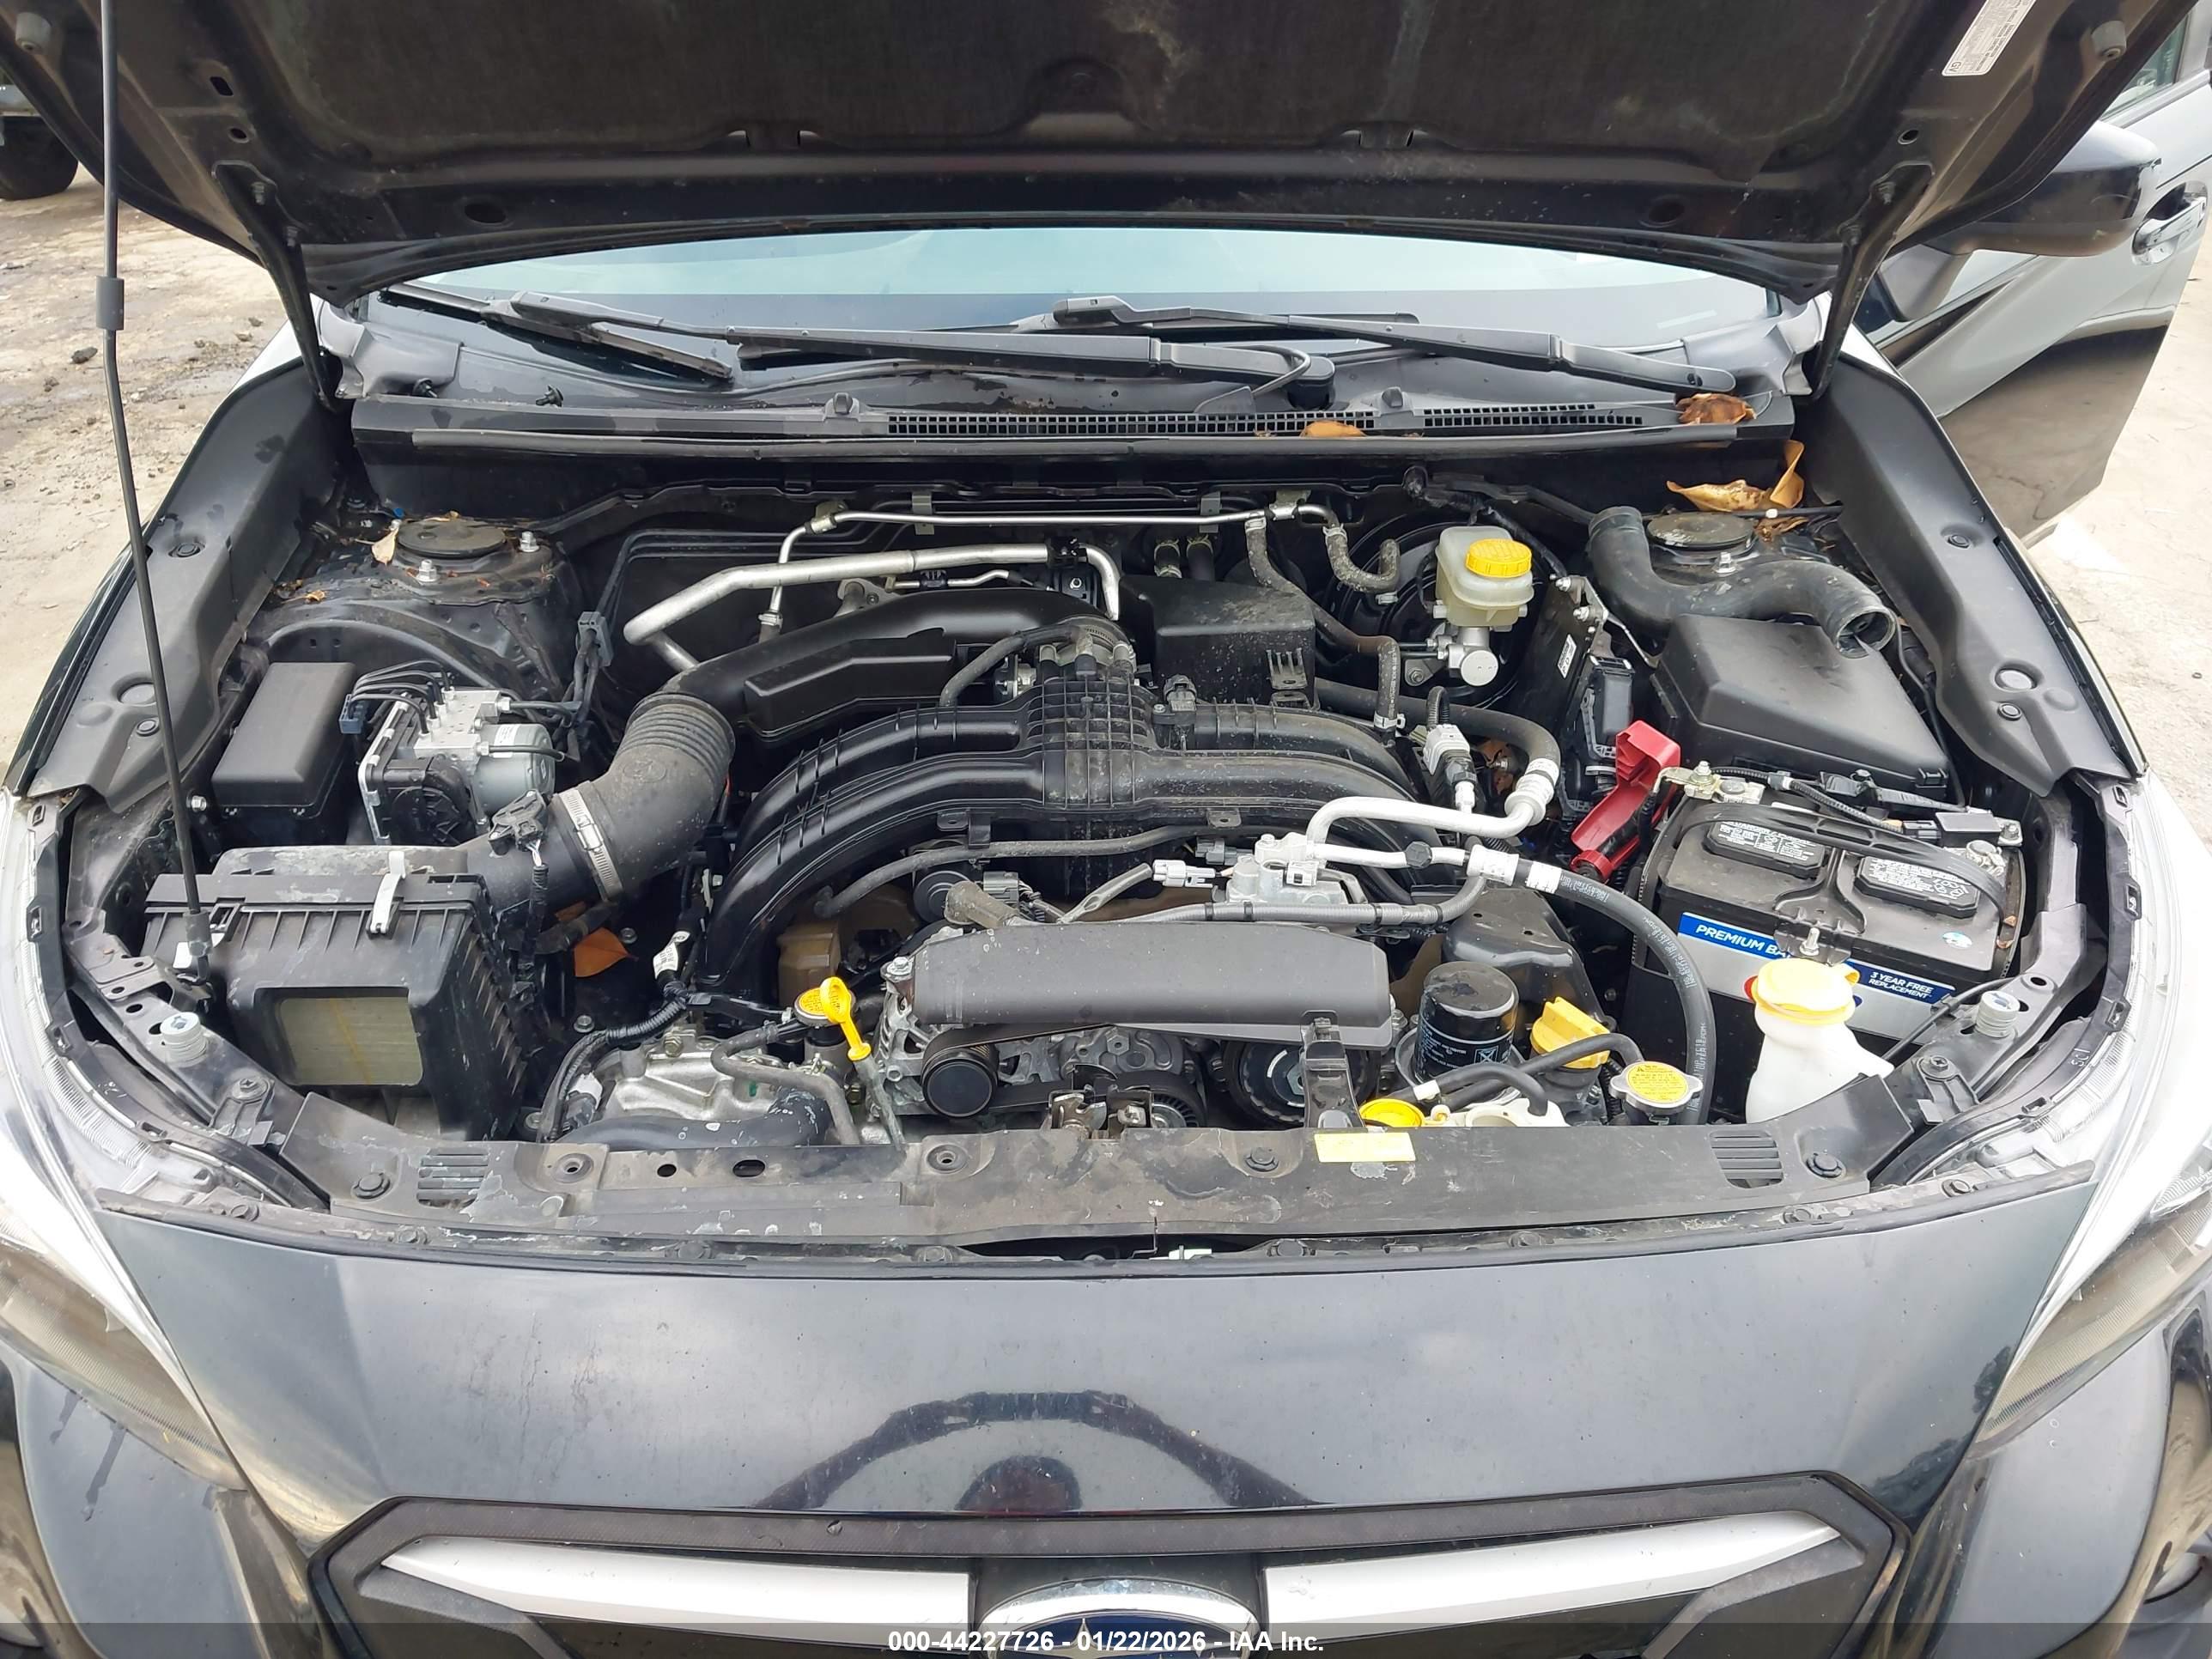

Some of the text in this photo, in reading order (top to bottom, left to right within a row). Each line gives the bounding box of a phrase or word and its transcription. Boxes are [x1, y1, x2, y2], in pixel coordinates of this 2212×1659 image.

[1695, 924, 1766, 951] PREMIUM
[1869, 979, 1929, 999] REPLACEMENT
[1880, 973, 1906, 987] YEAR
[1905, 981, 1935, 994] FREE
